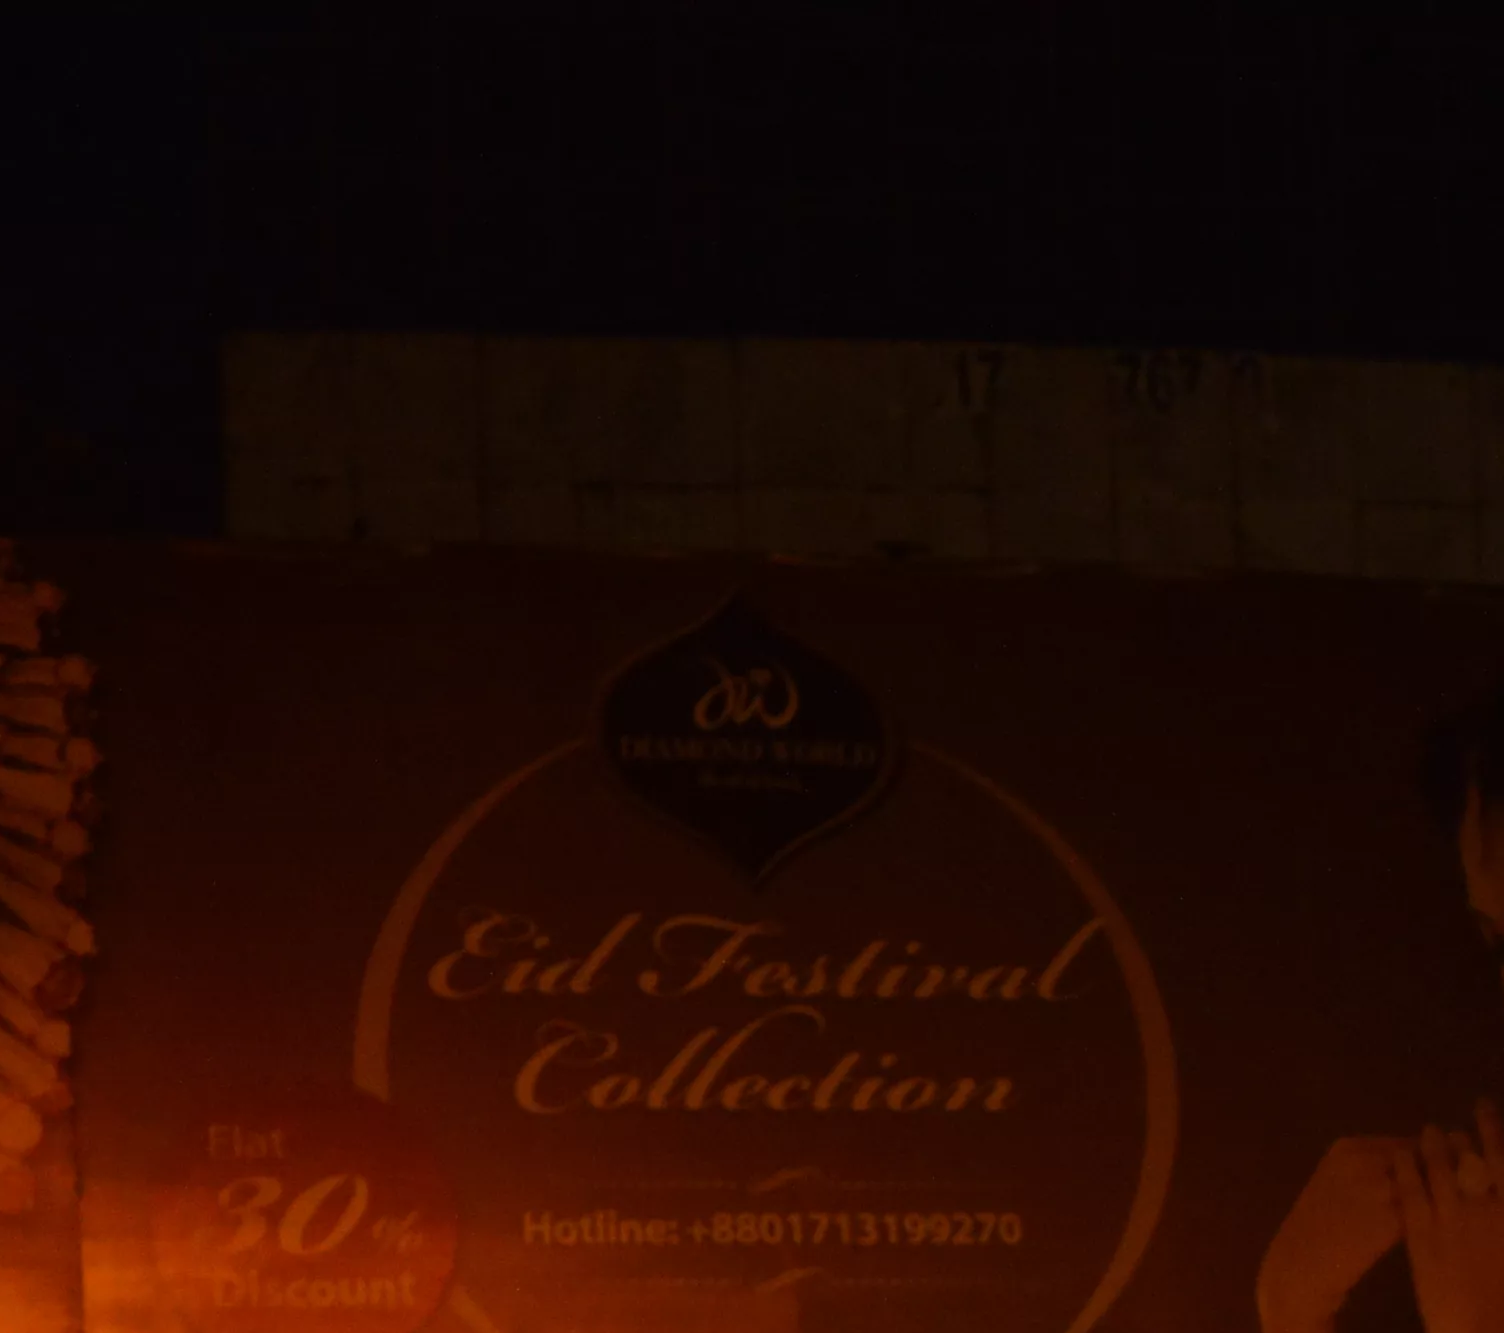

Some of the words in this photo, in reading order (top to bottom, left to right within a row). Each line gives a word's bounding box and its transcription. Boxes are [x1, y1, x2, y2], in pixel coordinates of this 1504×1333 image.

[428, 904, 644, 1000] Eid
[637, 912, 1108, 1000] Festival
[514, 1003, 1016, 1114] Collection
[207, 1124, 287, 1159] Flat
[521, 1210, 681, 1247] Hotline:
[689, 1210, 1023, 1249] +8801713199270
[214, 1268, 417, 1309] Discount
